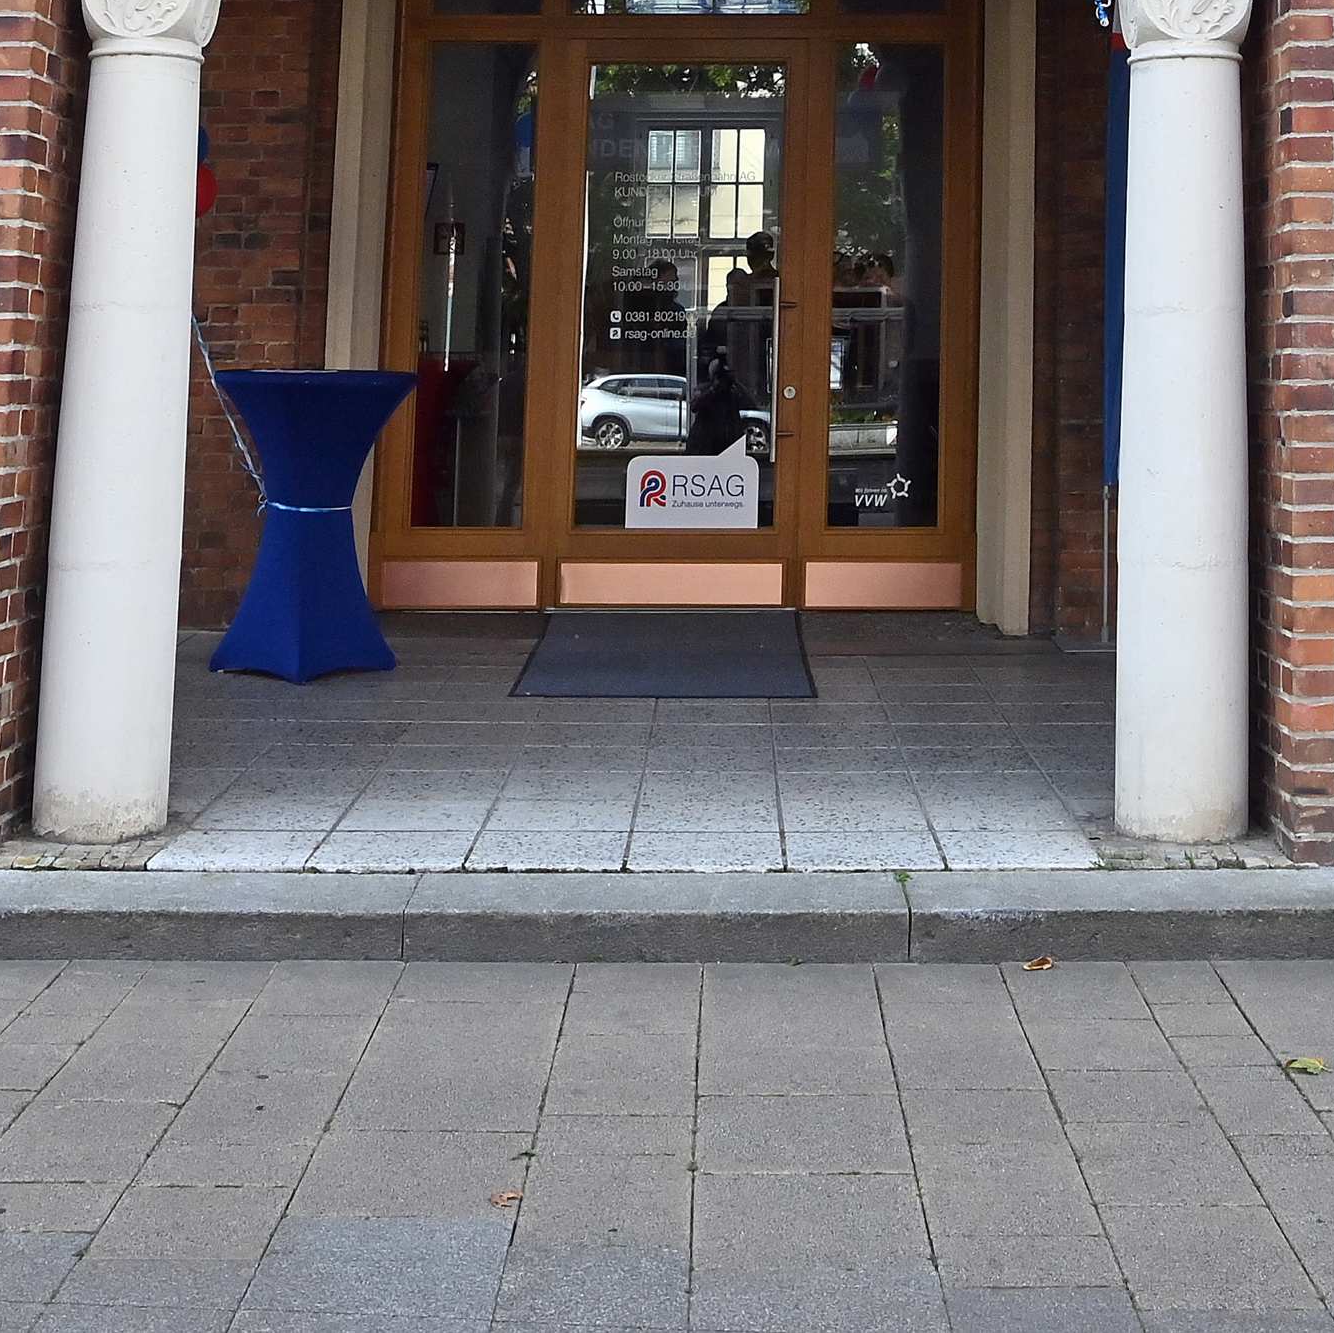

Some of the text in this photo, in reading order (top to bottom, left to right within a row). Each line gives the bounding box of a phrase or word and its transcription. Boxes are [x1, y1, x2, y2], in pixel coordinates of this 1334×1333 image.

[611, 265, 659, 279] Samstag
[624, 311, 650, 322] 0381
[671, 474, 745, 497] RSAG
